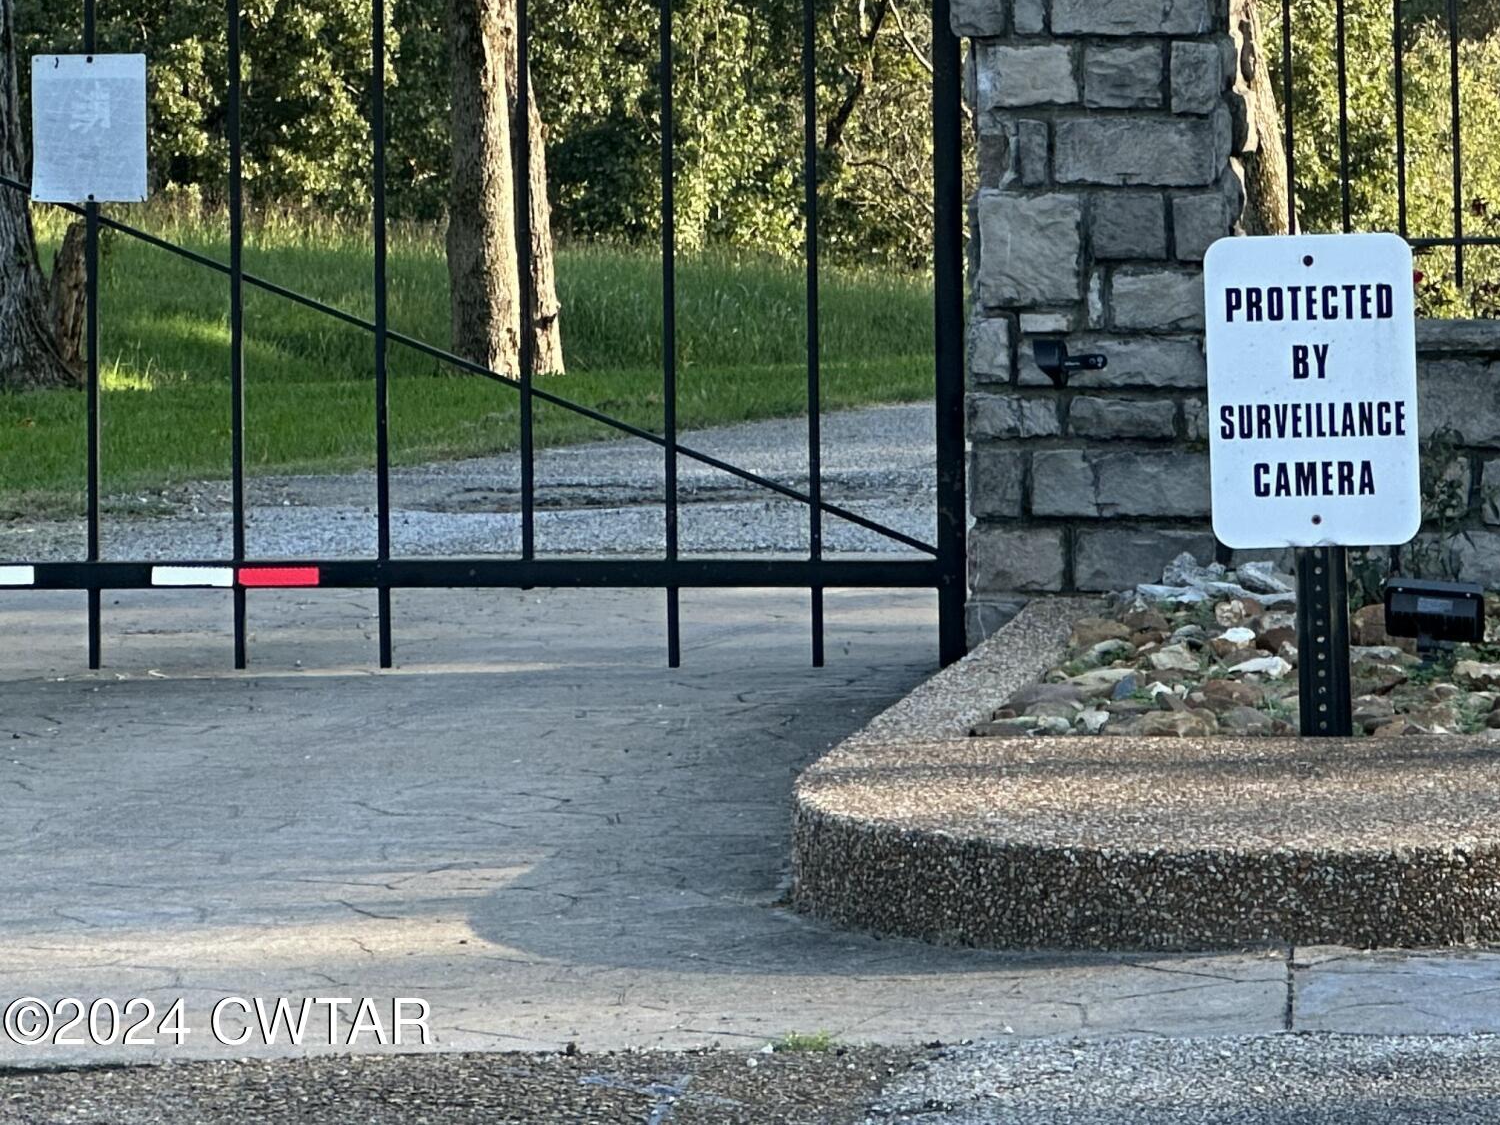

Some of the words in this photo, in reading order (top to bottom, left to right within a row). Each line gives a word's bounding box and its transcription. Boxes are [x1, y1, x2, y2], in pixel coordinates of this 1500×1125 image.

[1225, 283, 1393, 322] PROTECTED
[1292, 344, 1329, 379] BY
[1220, 401, 1406, 439] SURVEILLANCE
[1254, 460, 1375, 497] CAMERA
